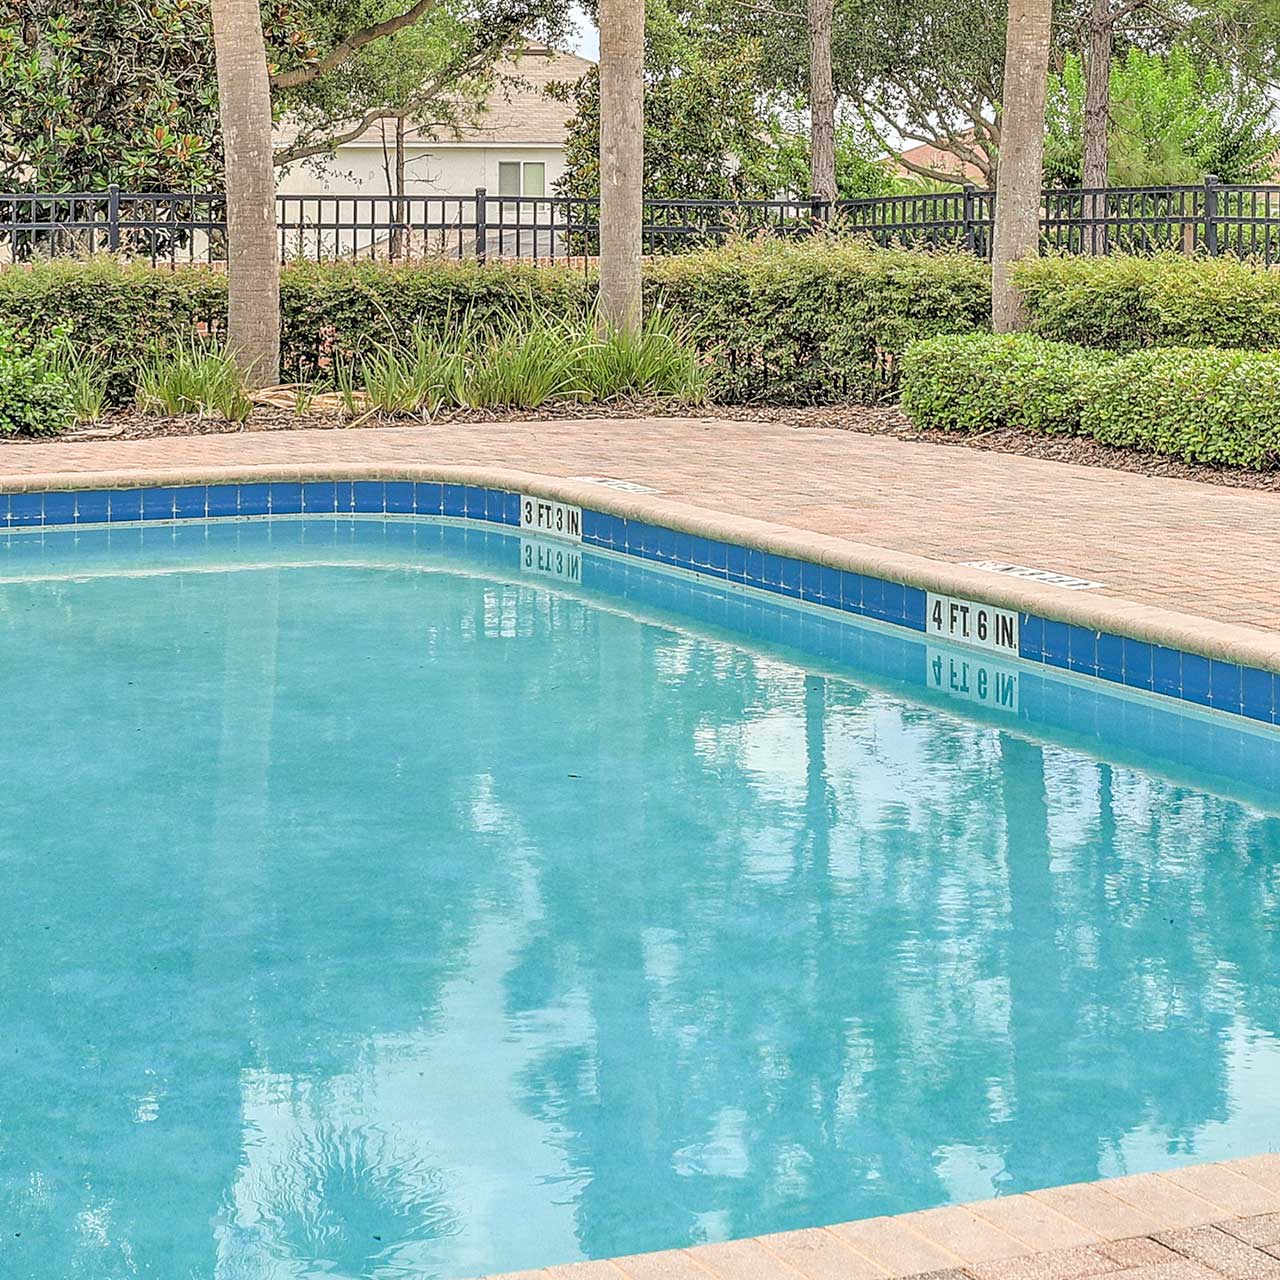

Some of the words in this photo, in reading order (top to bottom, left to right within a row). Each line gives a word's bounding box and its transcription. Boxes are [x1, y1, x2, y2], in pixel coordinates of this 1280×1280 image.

[524, 500, 533, 525] 3
[555, 507, 563, 532] 3
[932, 600, 943, 630] 4
[949, 603, 970, 637] FT.
[977, 609, 987, 641] 6
[995, 613, 1017, 649] IN.
